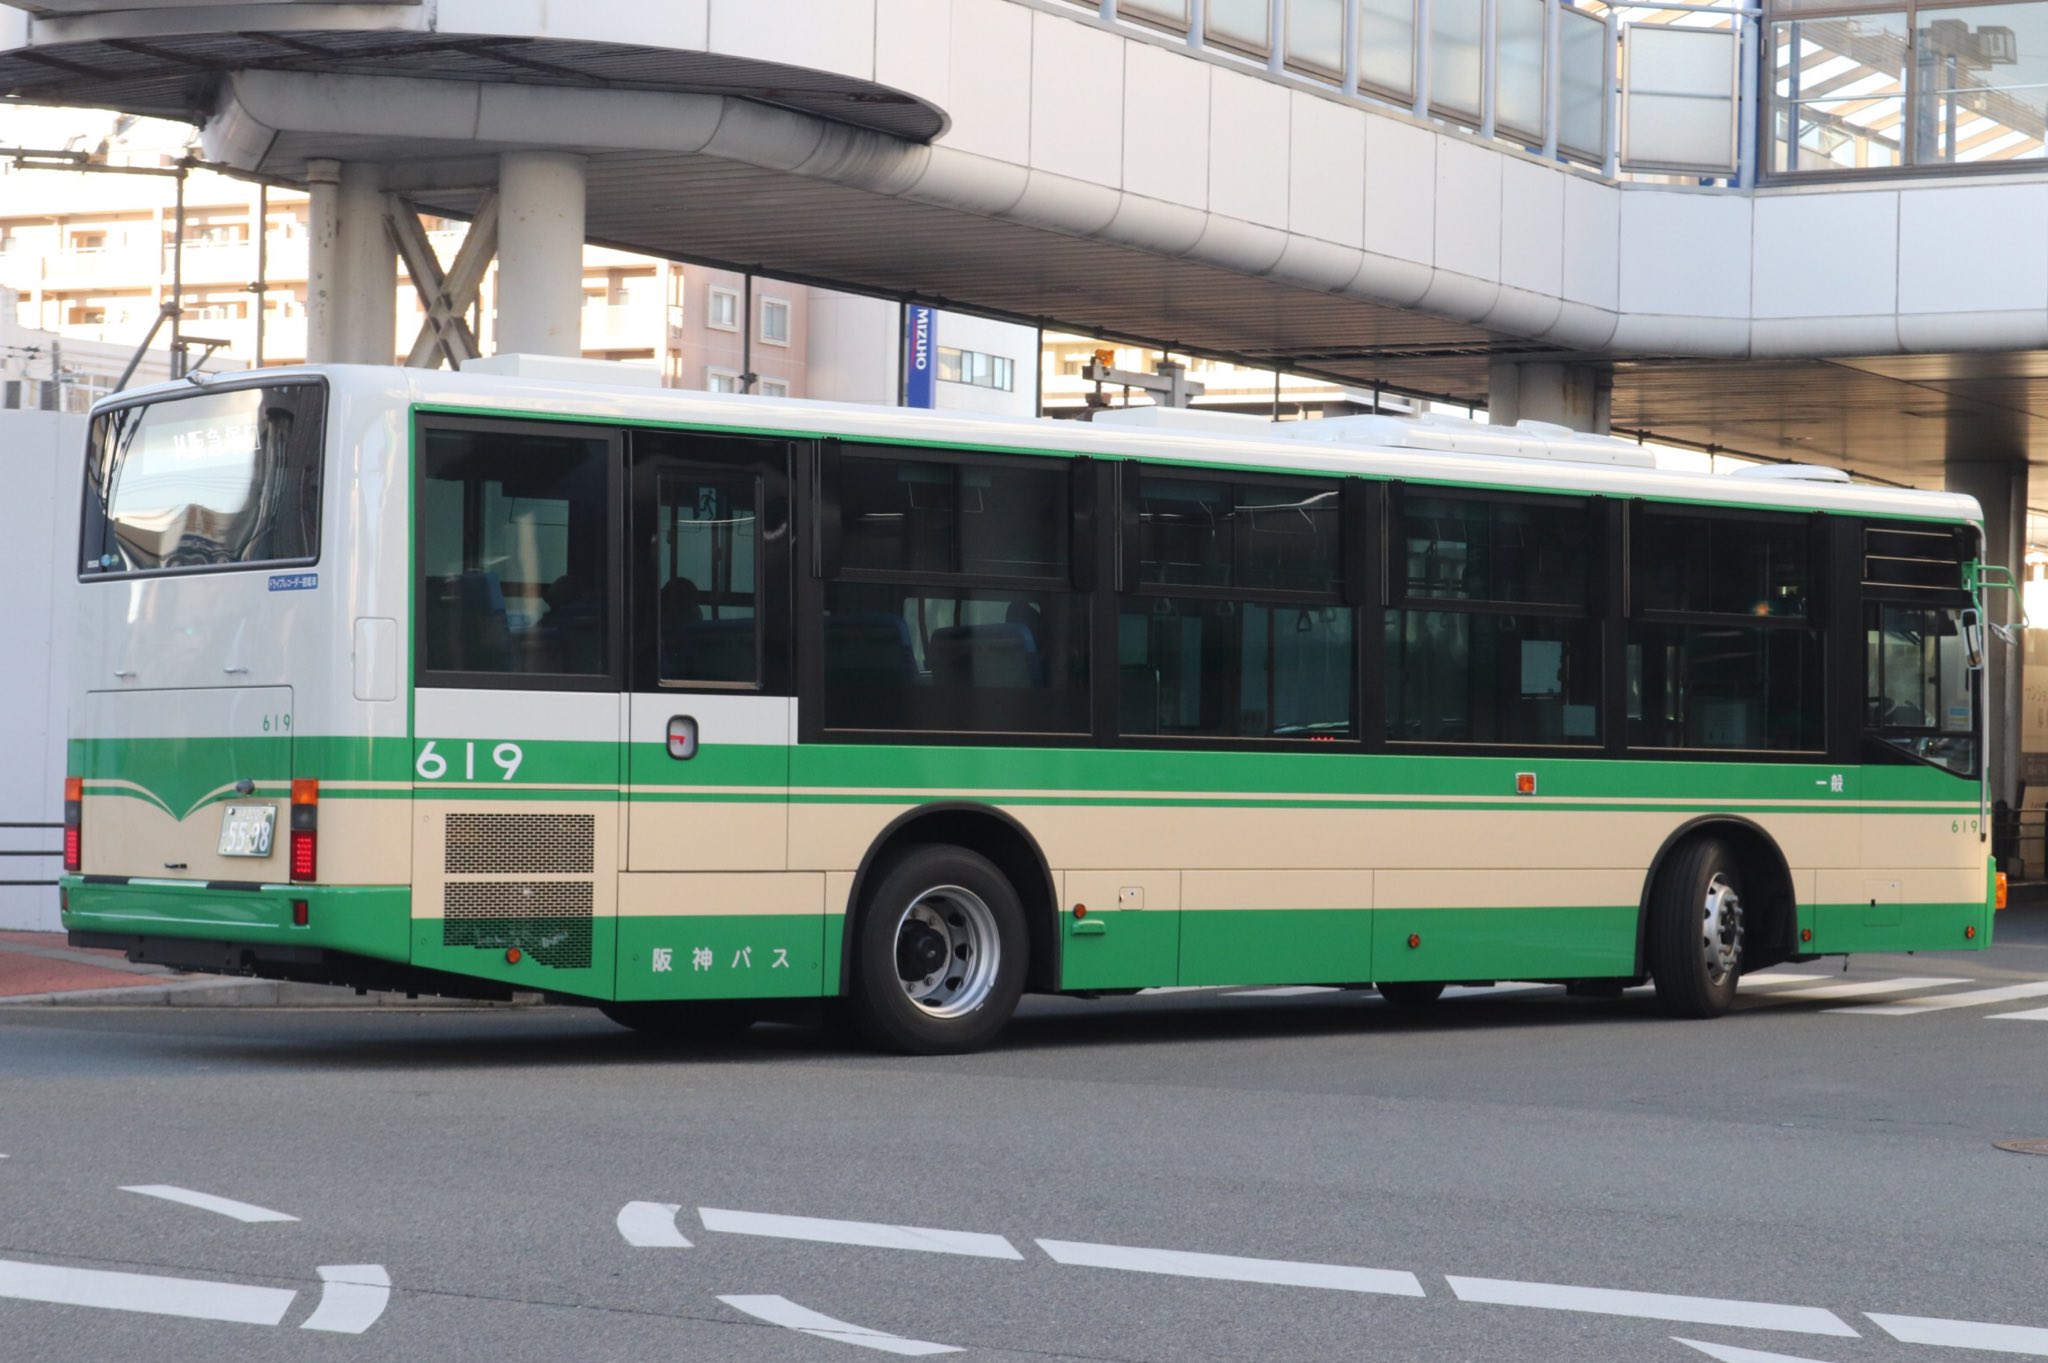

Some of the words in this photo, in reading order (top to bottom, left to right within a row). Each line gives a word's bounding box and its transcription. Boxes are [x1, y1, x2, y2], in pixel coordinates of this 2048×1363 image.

[915, 308, 929, 370] MIZUHO
[263, 713, 291, 731] 619
[416, 741, 523, 780] 619
[1816, 774, 1843, 792] 一般
[1952, 820, 1978, 833] 619
[652, 946, 790, 973] 阪神バス
